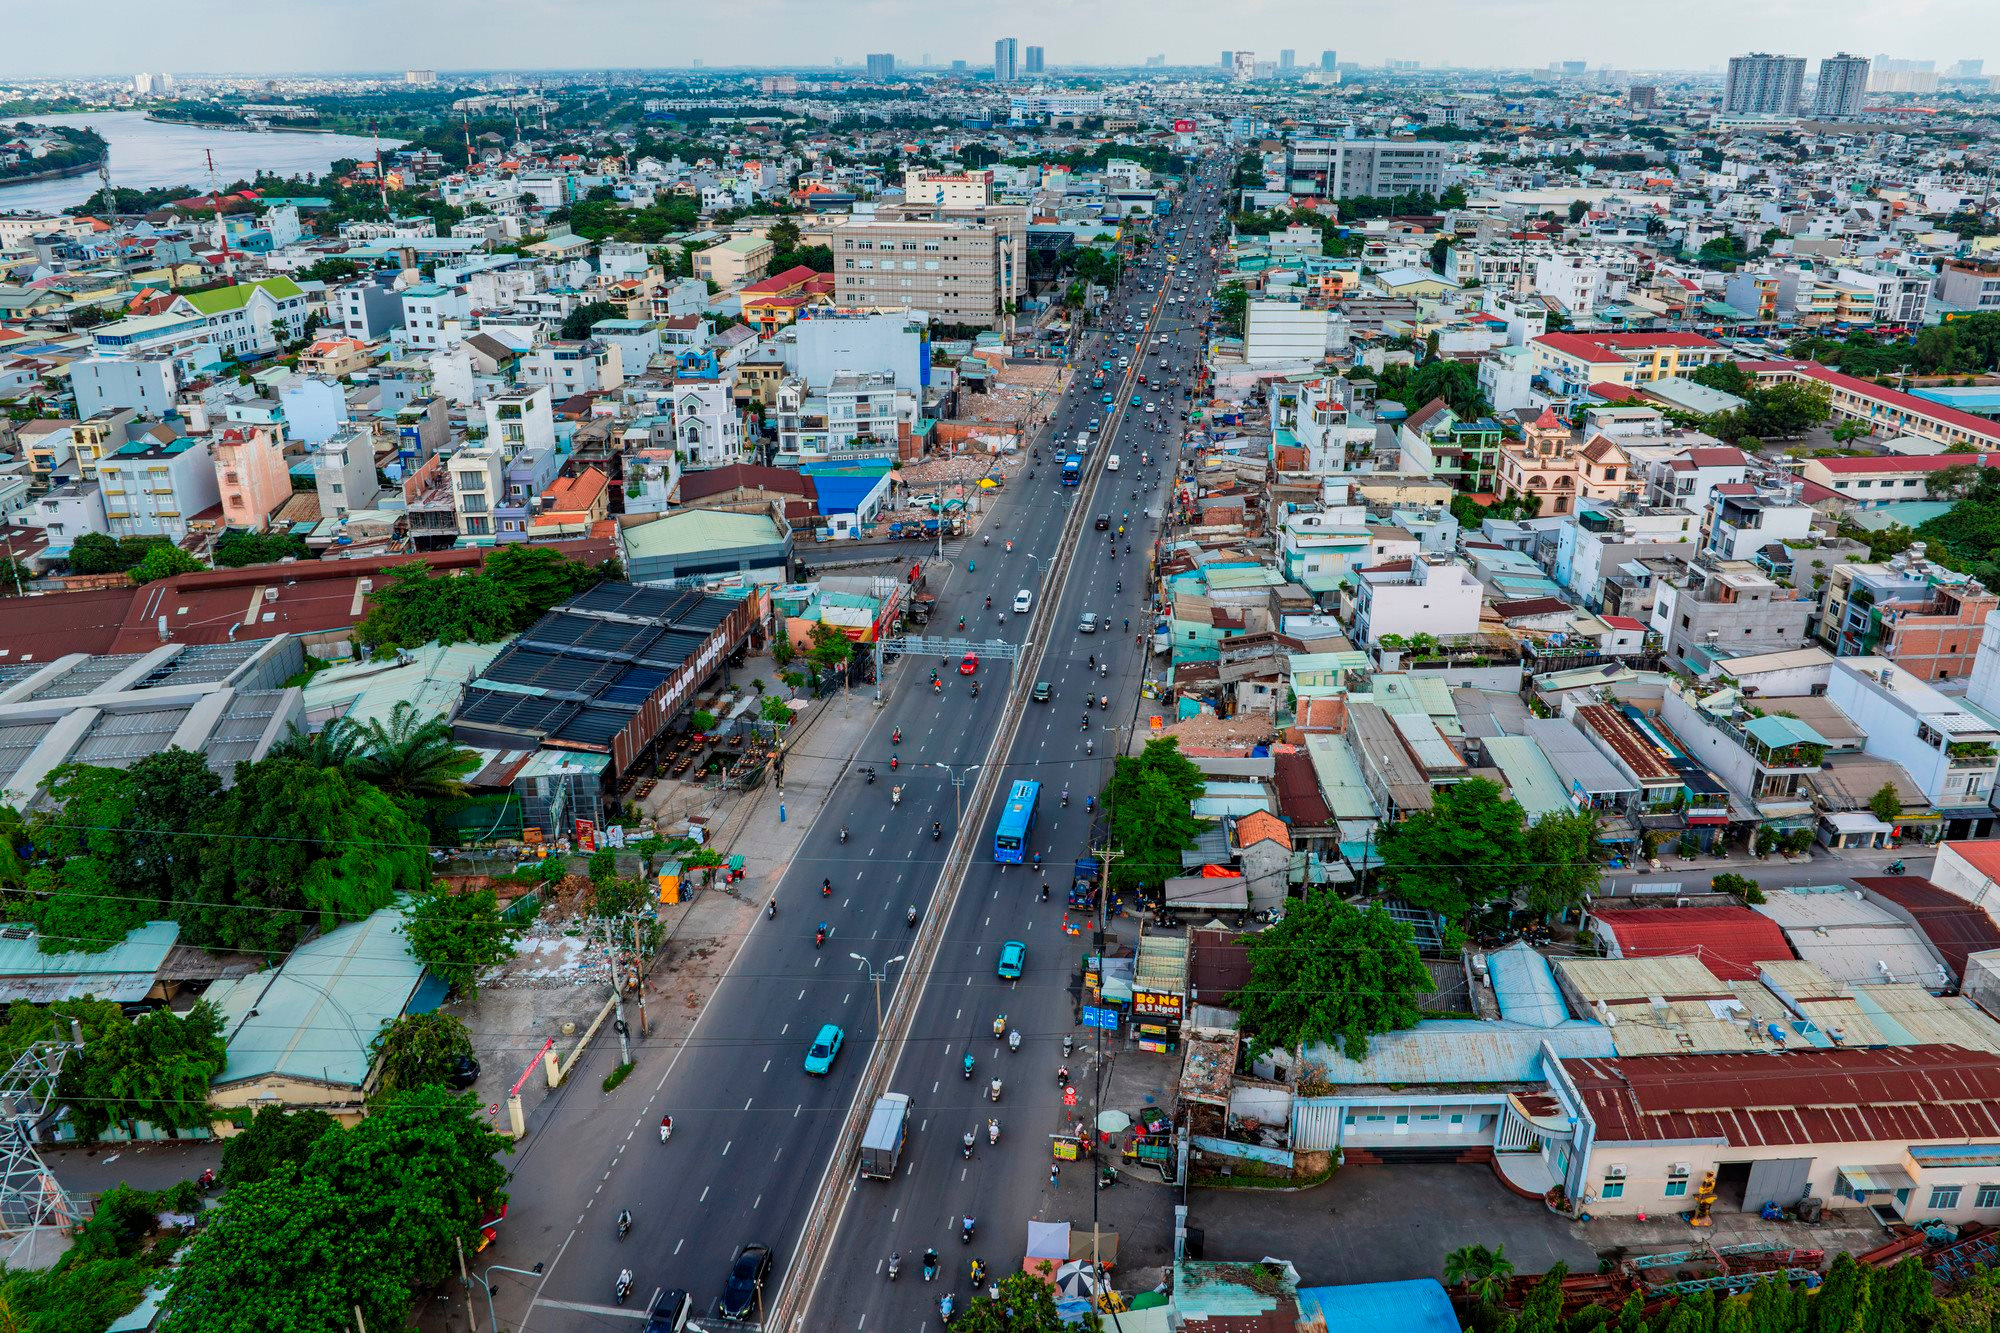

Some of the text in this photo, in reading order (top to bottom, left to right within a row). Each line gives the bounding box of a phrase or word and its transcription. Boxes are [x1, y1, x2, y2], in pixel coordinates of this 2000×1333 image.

[659, 633, 726, 712] TRẠM NHẬU
[1136, 993, 1179, 1006] Bò Né
[1155, 1004, 1180, 1014] Ngon
